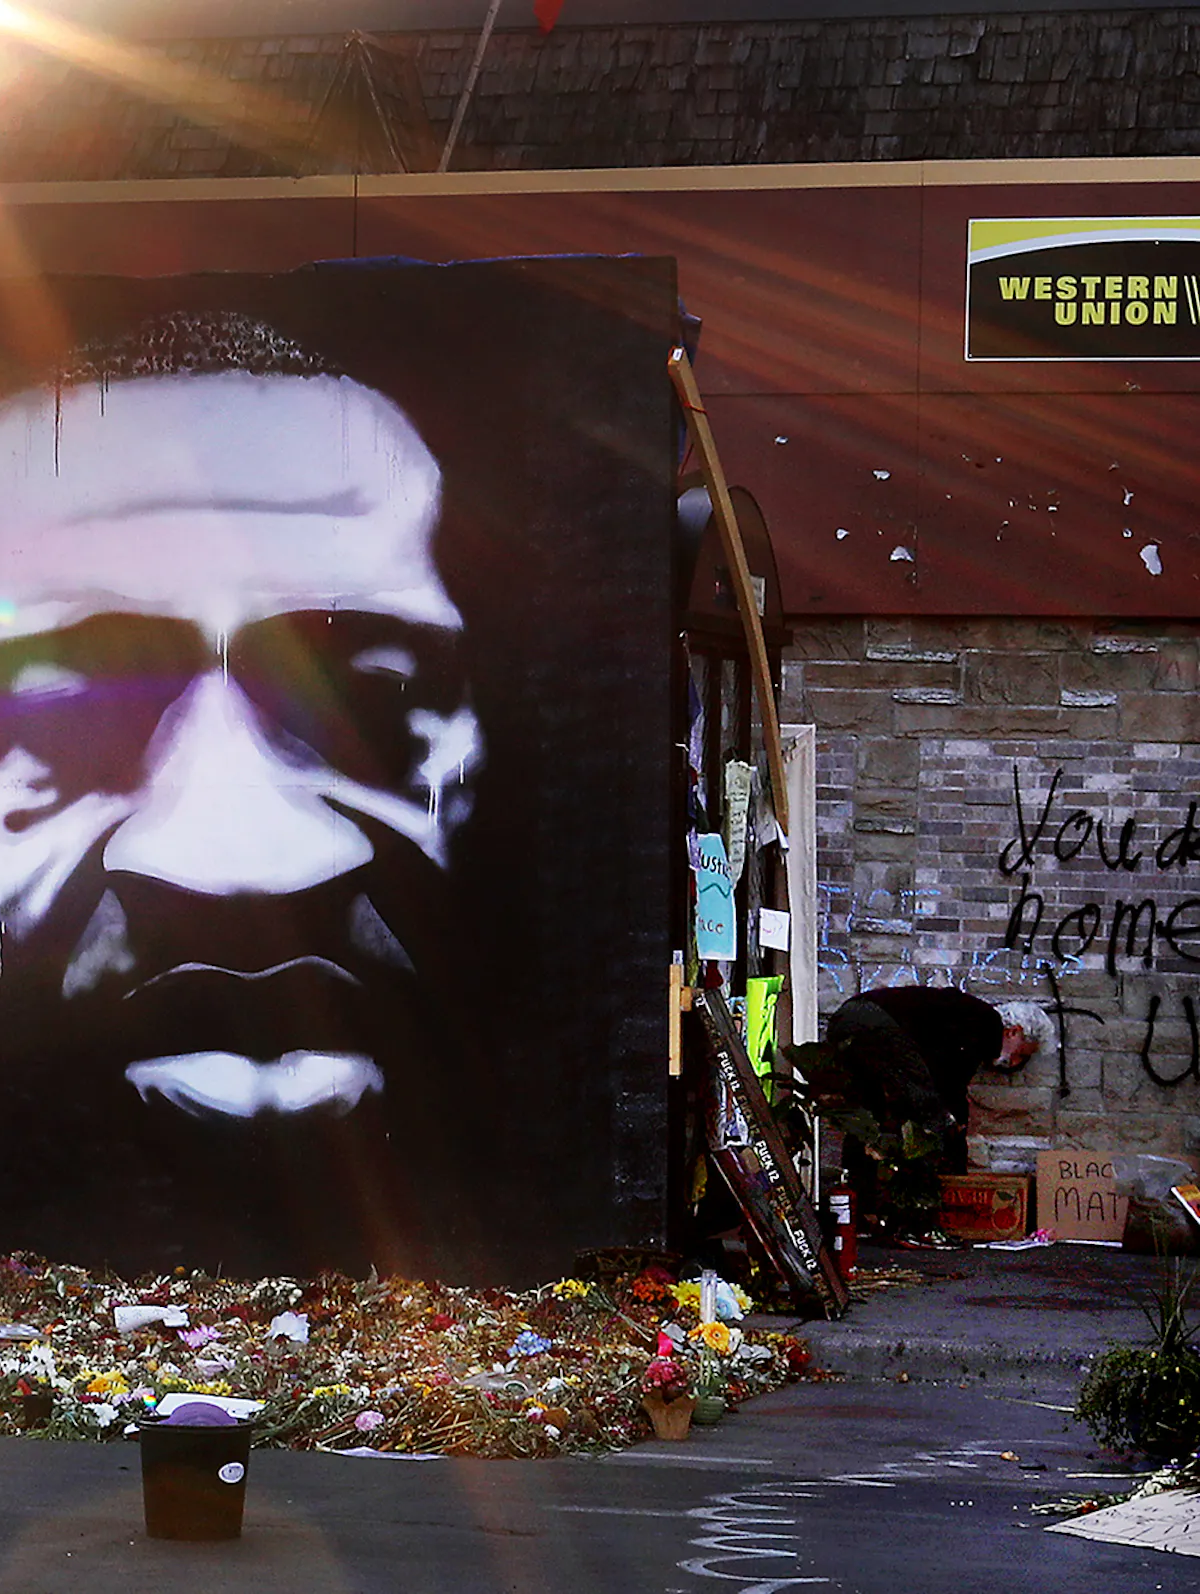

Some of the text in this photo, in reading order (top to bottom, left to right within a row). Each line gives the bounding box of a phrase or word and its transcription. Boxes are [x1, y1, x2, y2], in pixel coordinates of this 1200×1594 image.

[999, 276, 1178, 300] WESTERN
[1054, 301, 1177, 326] UNION
[1000, 764, 1143, 868] You
[717, 1050, 737, 1081] FUCK
[755, 1140, 780, 1184] FUCK 12
[1058, 1160, 1116, 1180] BLAC
[793, 1229, 819, 1272] FUCK 12
